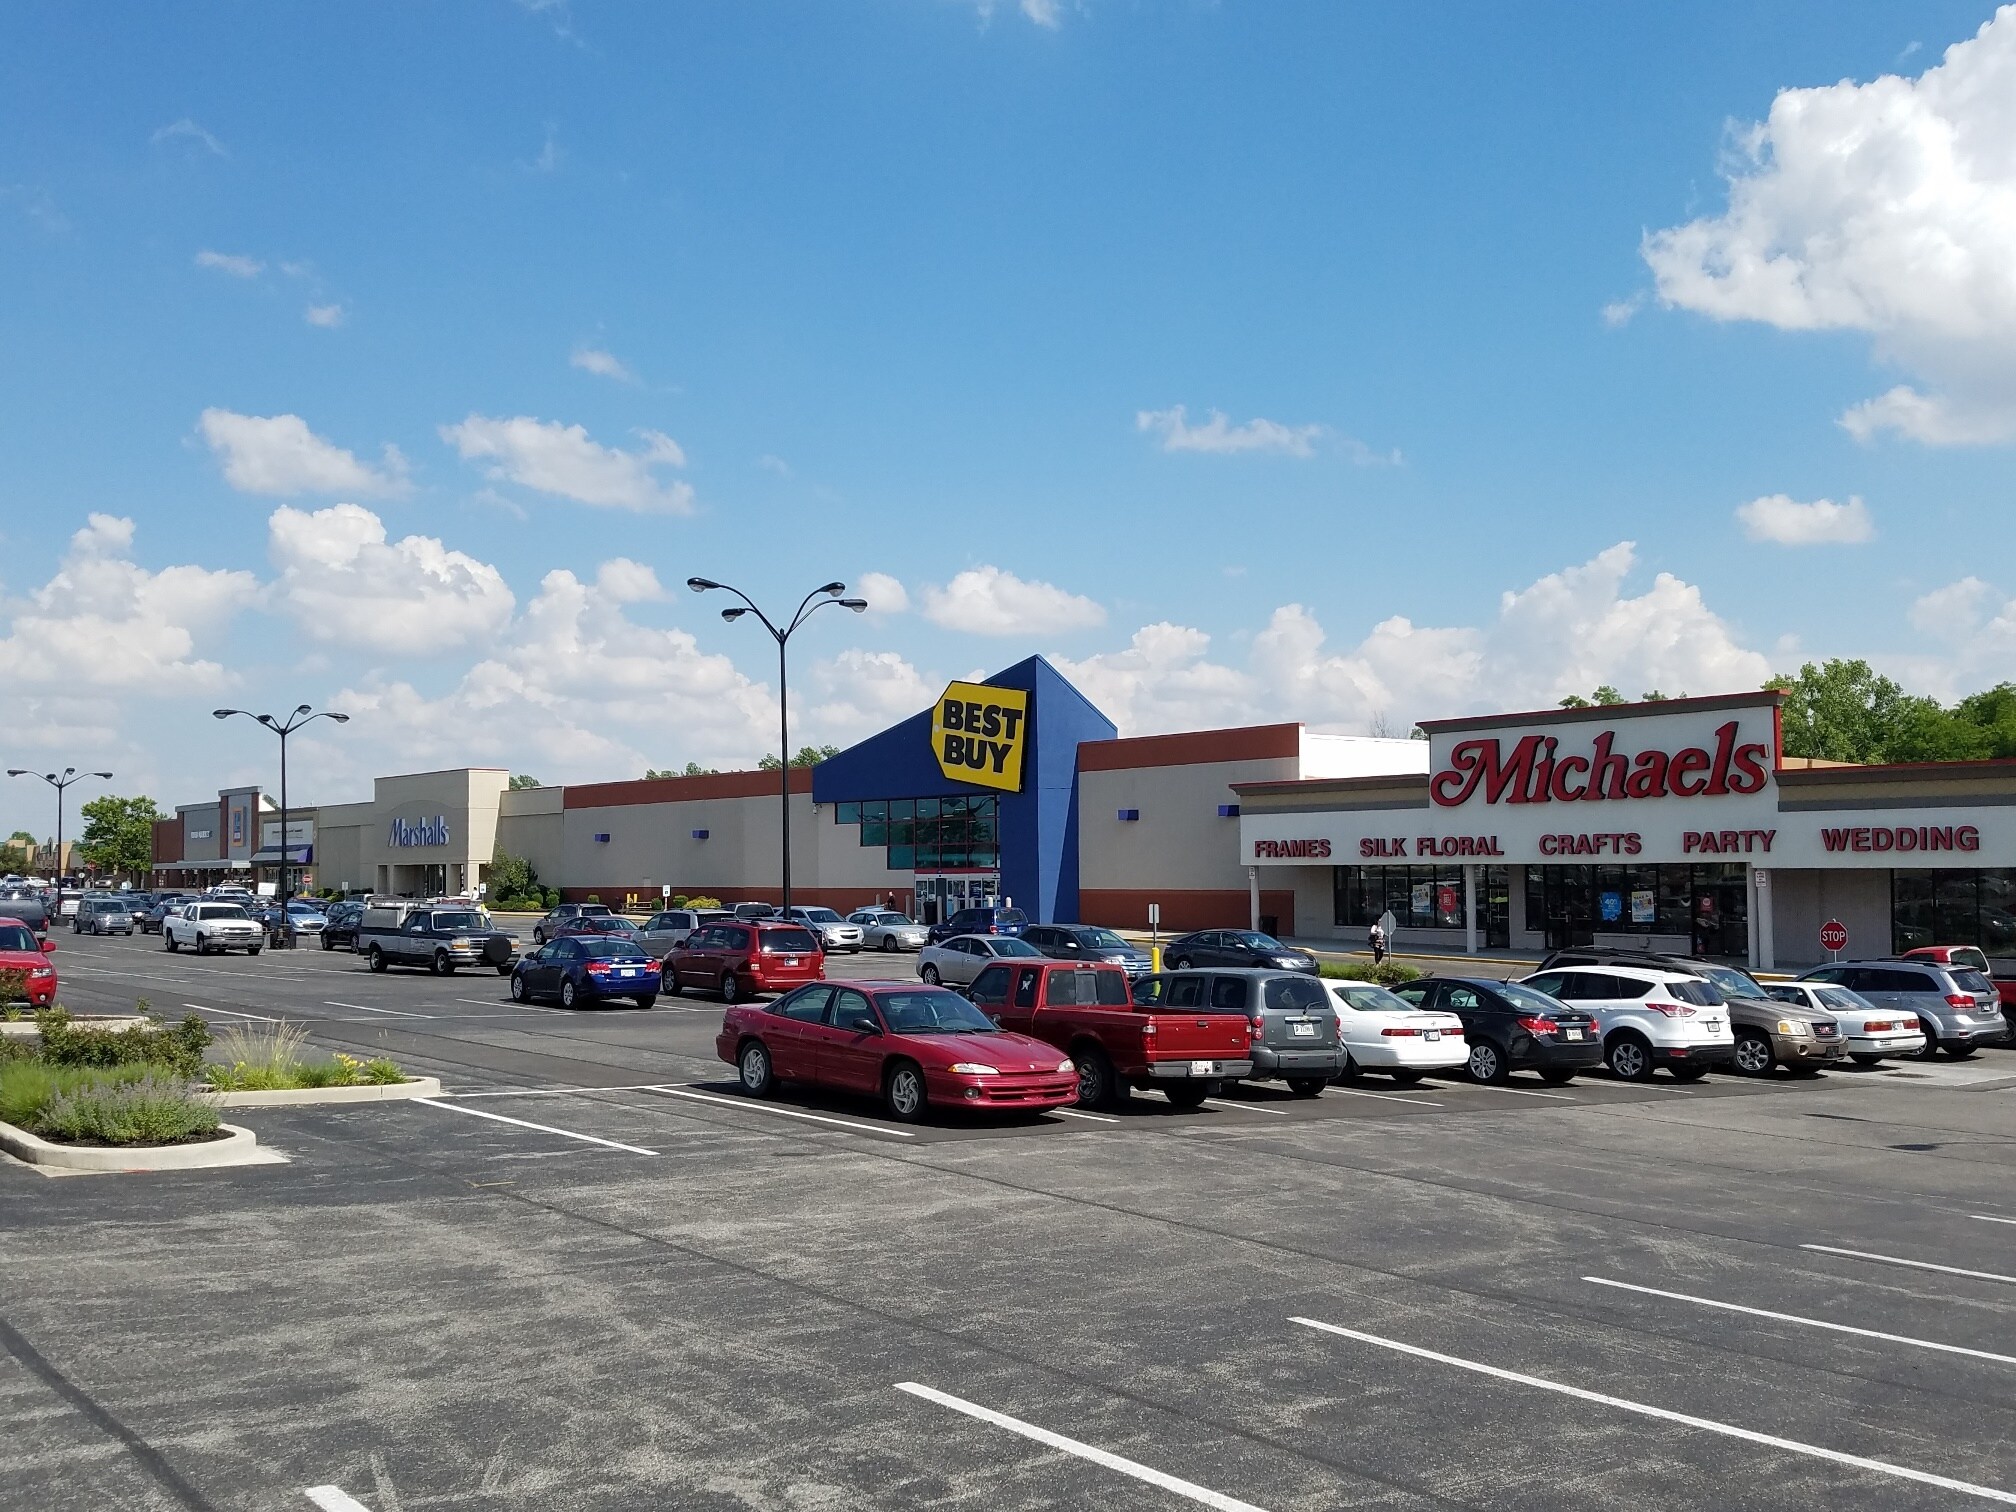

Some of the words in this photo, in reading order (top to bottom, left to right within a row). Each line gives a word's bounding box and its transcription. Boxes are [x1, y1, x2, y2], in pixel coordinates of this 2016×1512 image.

[943, 699, 1023, 740] BEST
[944, 733, 1013, 773] BUY
[1430, 721, 1769, 806] Michaels
[388, 816, 450, 847] Marshalls
[1539, 832, 1642, 855] CRAFTS
[1683, 829, 1776, 853] PARTY
[1821, 826, 1979, 851] WEDDING
[1254, 839, 1331, 858] FRAMES
[1359, 838, 1407, 857] SILK
[1416, 836, 1504, 856] FLORAL
[1822, 930, 1846, 941] STOP
